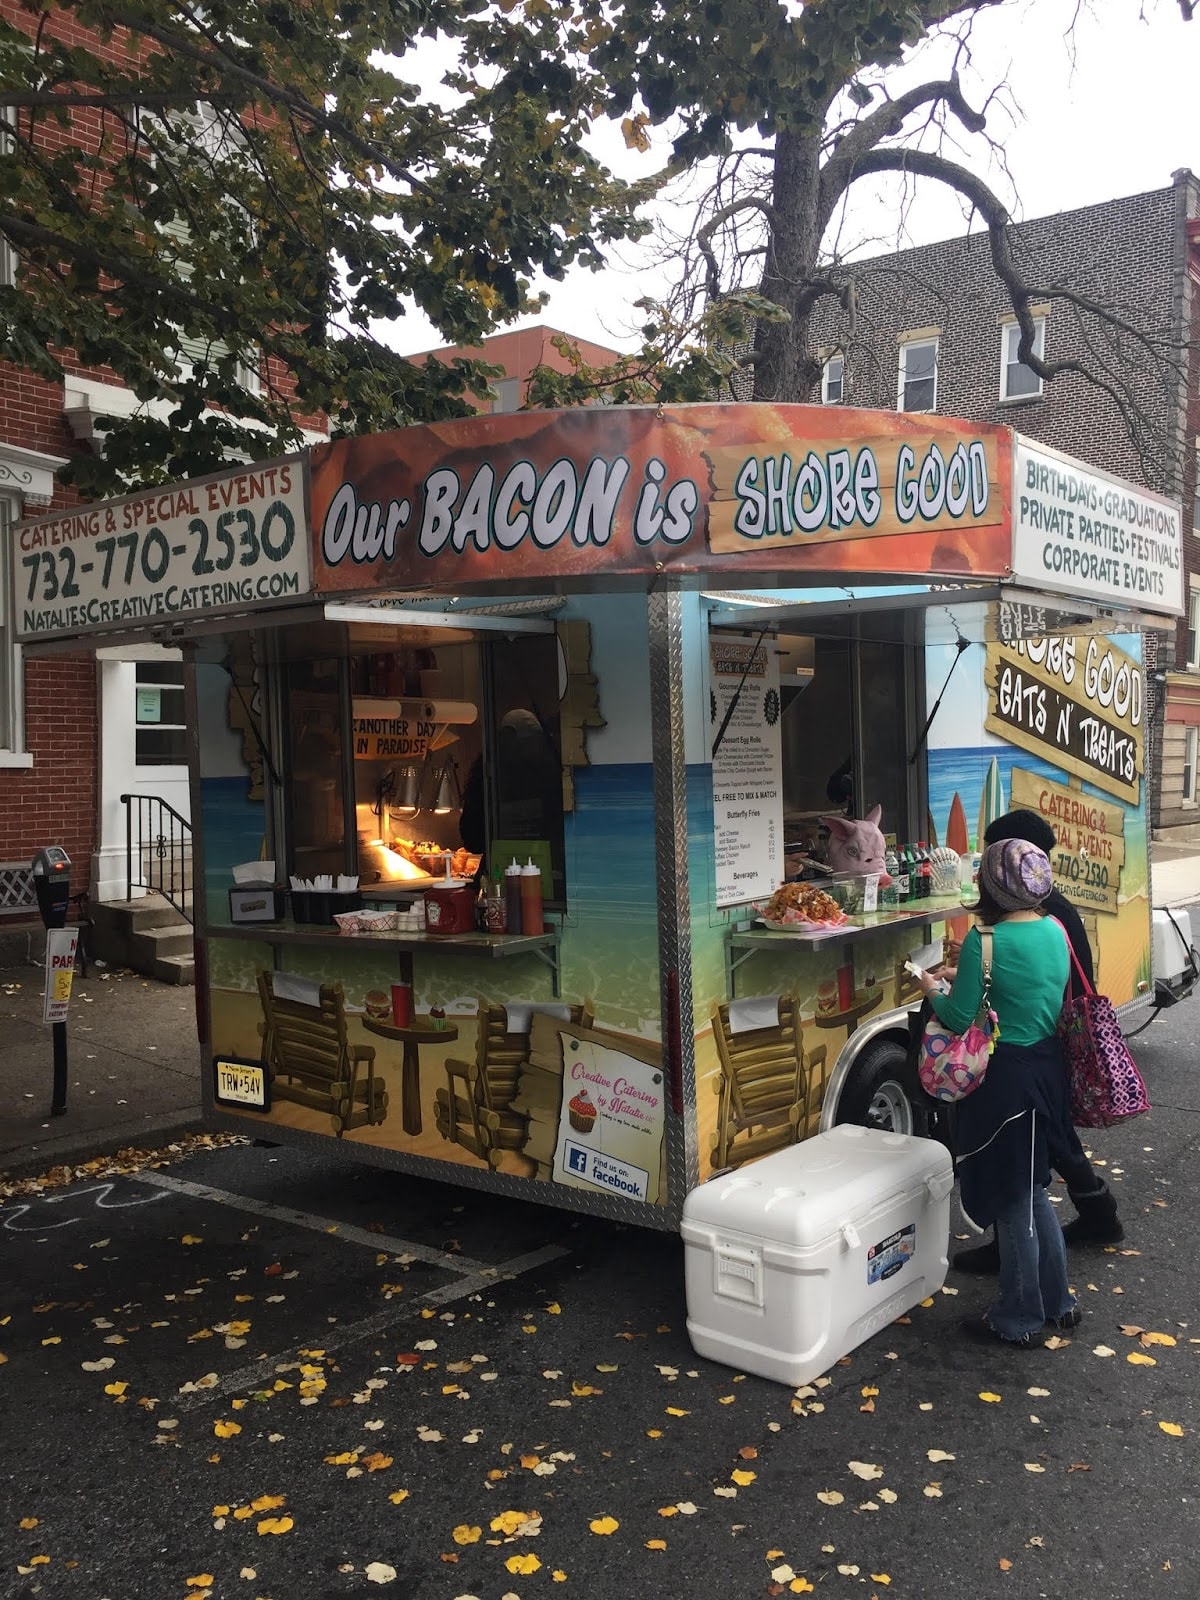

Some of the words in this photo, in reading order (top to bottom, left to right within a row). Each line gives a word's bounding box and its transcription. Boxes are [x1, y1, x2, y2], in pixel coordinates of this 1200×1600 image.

[20, 511, 100, 551] CATERING
[105, 508, 116, 533] &
[123, 489, 200, 529] SPECIAL
[205, 466, 292, 511] EVENTS
[323, 480, 411, 567] Our
[418, 456, 631, 557] BACON
[635, 457, 699, 547] is
[735, 447, 882, 539] SHORE
[895, 440, 990, 524] GOOD
[1020, 496, 1074, 540] PRIVATE
[22, 500, 296, 602] 732-770-2530
[1043, 542, 1119, 586] CORPORATE
[1123, 563, 1164, 595] EVENTS
[23, 572, 299, 632] NATALIESCREATIVECATERING.COM
[1001, 635, 1076, 684] ORE
[1085, 637, 1142, 726] GOOD
[359, 718, 409, 737] ANOTHER
[416, 721, 436, 737] DAY
[740, 736, 749, 745] Egg
[1000, 667, 1047, 735] EATS
[1079, 717, 1135, 782] TREATS
[357, 738, 369, 754] IN
[376, 738, 427, 754] PARADISE
[722, 793, 736, 801] FREE
[738, 792, 745, 800] TO
[727, 810, 748, 819] Butterfly
[749, 809, 760, 817] Fries
[1039, 789, 1097, 832] CATERING
[1101, 811, 1107, 835] &
[1046, 821, 1073, 850] CIAL
[1077, 830, 1113, 861] EVENTS
[733, 871, 759, 880] Beverages
[1052, 853, 1109, 890] -770-2530
[571, 1062, 611, 1088] Creative
[613, 1077, 660, 1108] Catering
[597, 1094, 607, 1108] by
[608, 1097, 645, 1120] Natalie
[593, 1156, 608, 1169] Find
[608, 1164, 618, 1173] us
